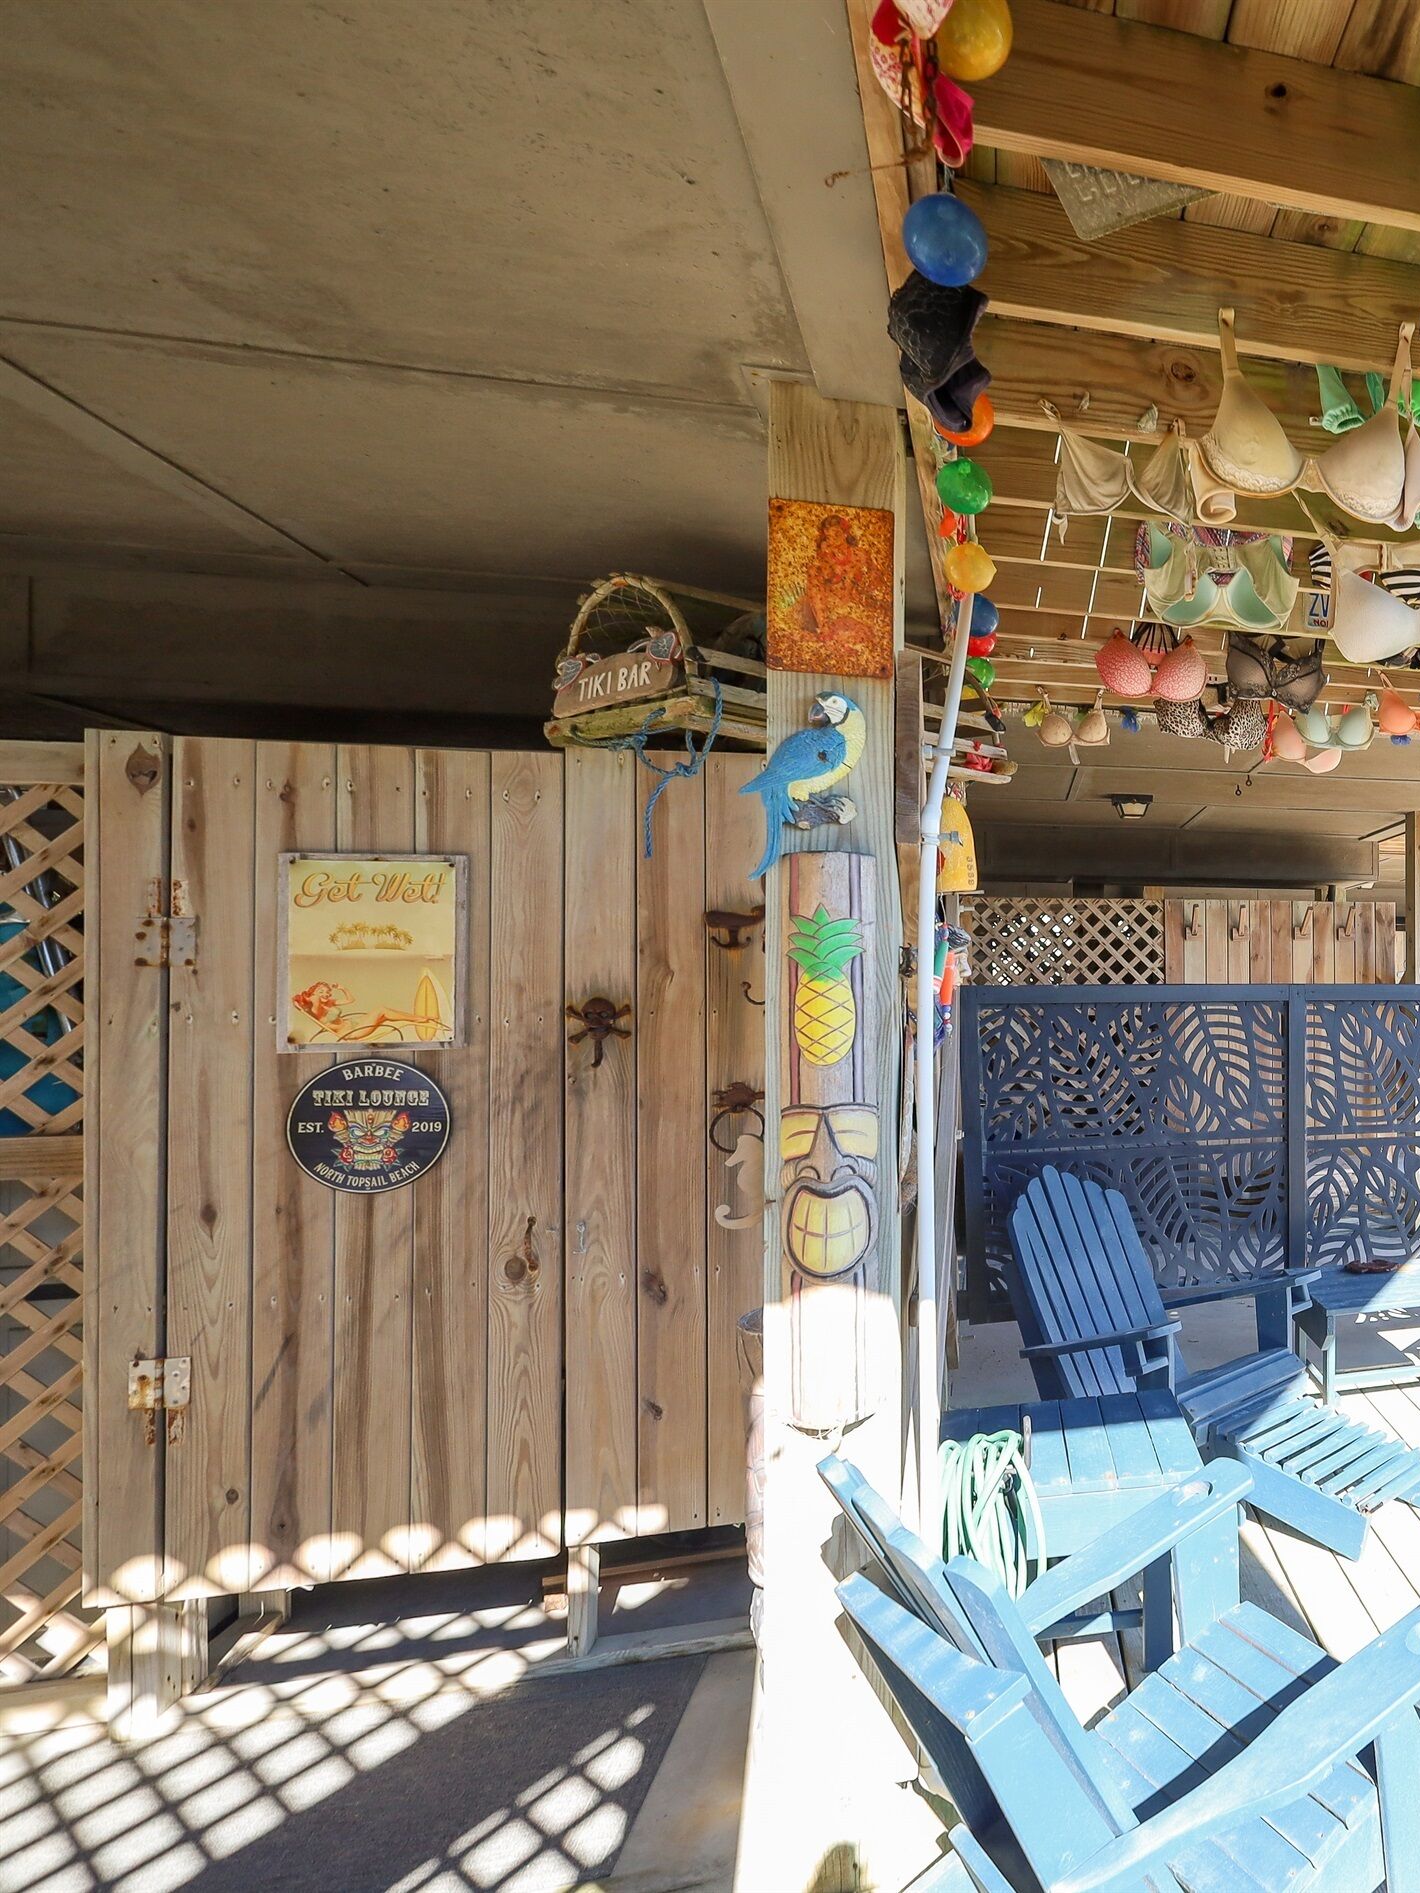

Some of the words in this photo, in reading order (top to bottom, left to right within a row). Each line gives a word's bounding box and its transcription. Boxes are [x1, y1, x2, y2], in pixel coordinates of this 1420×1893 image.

[578, 671, 612, 702] TIKI
[617, 661, 651, 692] BAR
[294, 872, 367, 908] Get
[371, 872, 447, 904] Wet!
[341, 1065, 405, 1082] BARBEE
[312, 1089, 353, 1107] TIKI
[358, 1089, 430, 1106] LOUNGE
[297, 1122, 324, 1133] EST.
[411, 1121, 442, 1132] 2019
[313, 1162, 345, 1184] NORTH
[347, 1175, 388, 1187] TOPSAIL
[390, 1161, 421, 1183] BEACH
